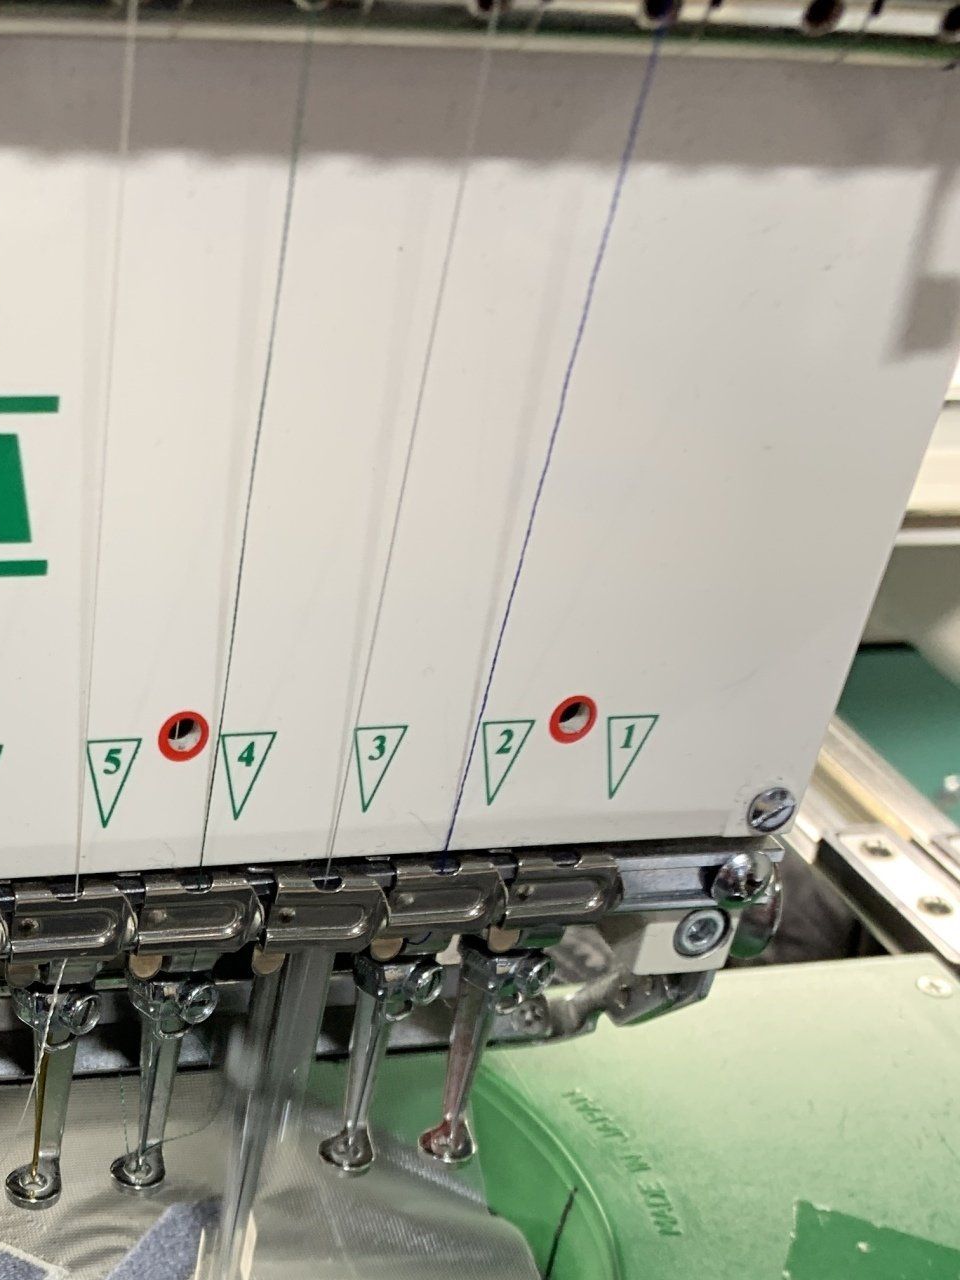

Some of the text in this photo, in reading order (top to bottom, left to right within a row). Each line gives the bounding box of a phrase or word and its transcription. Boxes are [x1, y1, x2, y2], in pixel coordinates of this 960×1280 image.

[368, 734, 386, 761] 3
[496, 729, 514, 754] 2
[621, 725, 635, 749] 1
[103, 748, 122, 774] 5
[237, 740, 255, 767] 4
